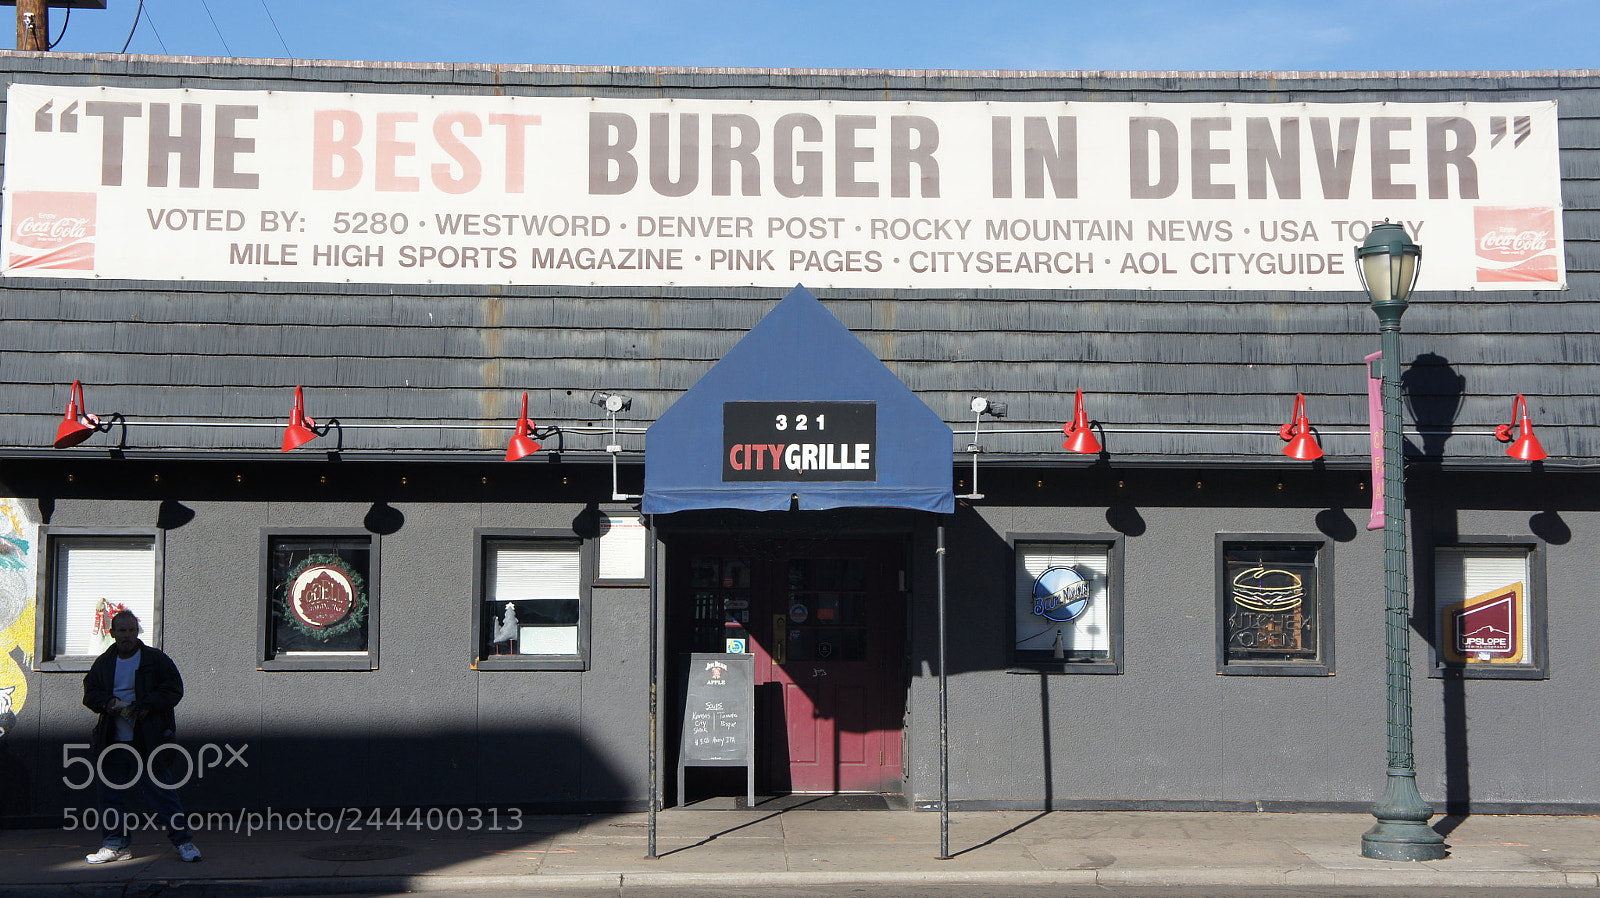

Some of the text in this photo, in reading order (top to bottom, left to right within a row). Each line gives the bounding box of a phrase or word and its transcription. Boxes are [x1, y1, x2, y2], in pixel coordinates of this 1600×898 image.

[313, 110, 541, 194] BEST
[588, 112, 940, 198] BURGER
[992, 116, 1078, 199] IN
[147, 209, 1424, 242] VOTED BY: 5280 WESTWORD DENVER POST ROCKY MOUNTAIN NEWS USA TOY
[230, 243, 1344, 275] MILE HIGH SPORTS MAGAZINE PINK PAGES CITYSEARCH AOL CITYGUIDE
[1462, 637, 1507, 646] UPSLOPE
